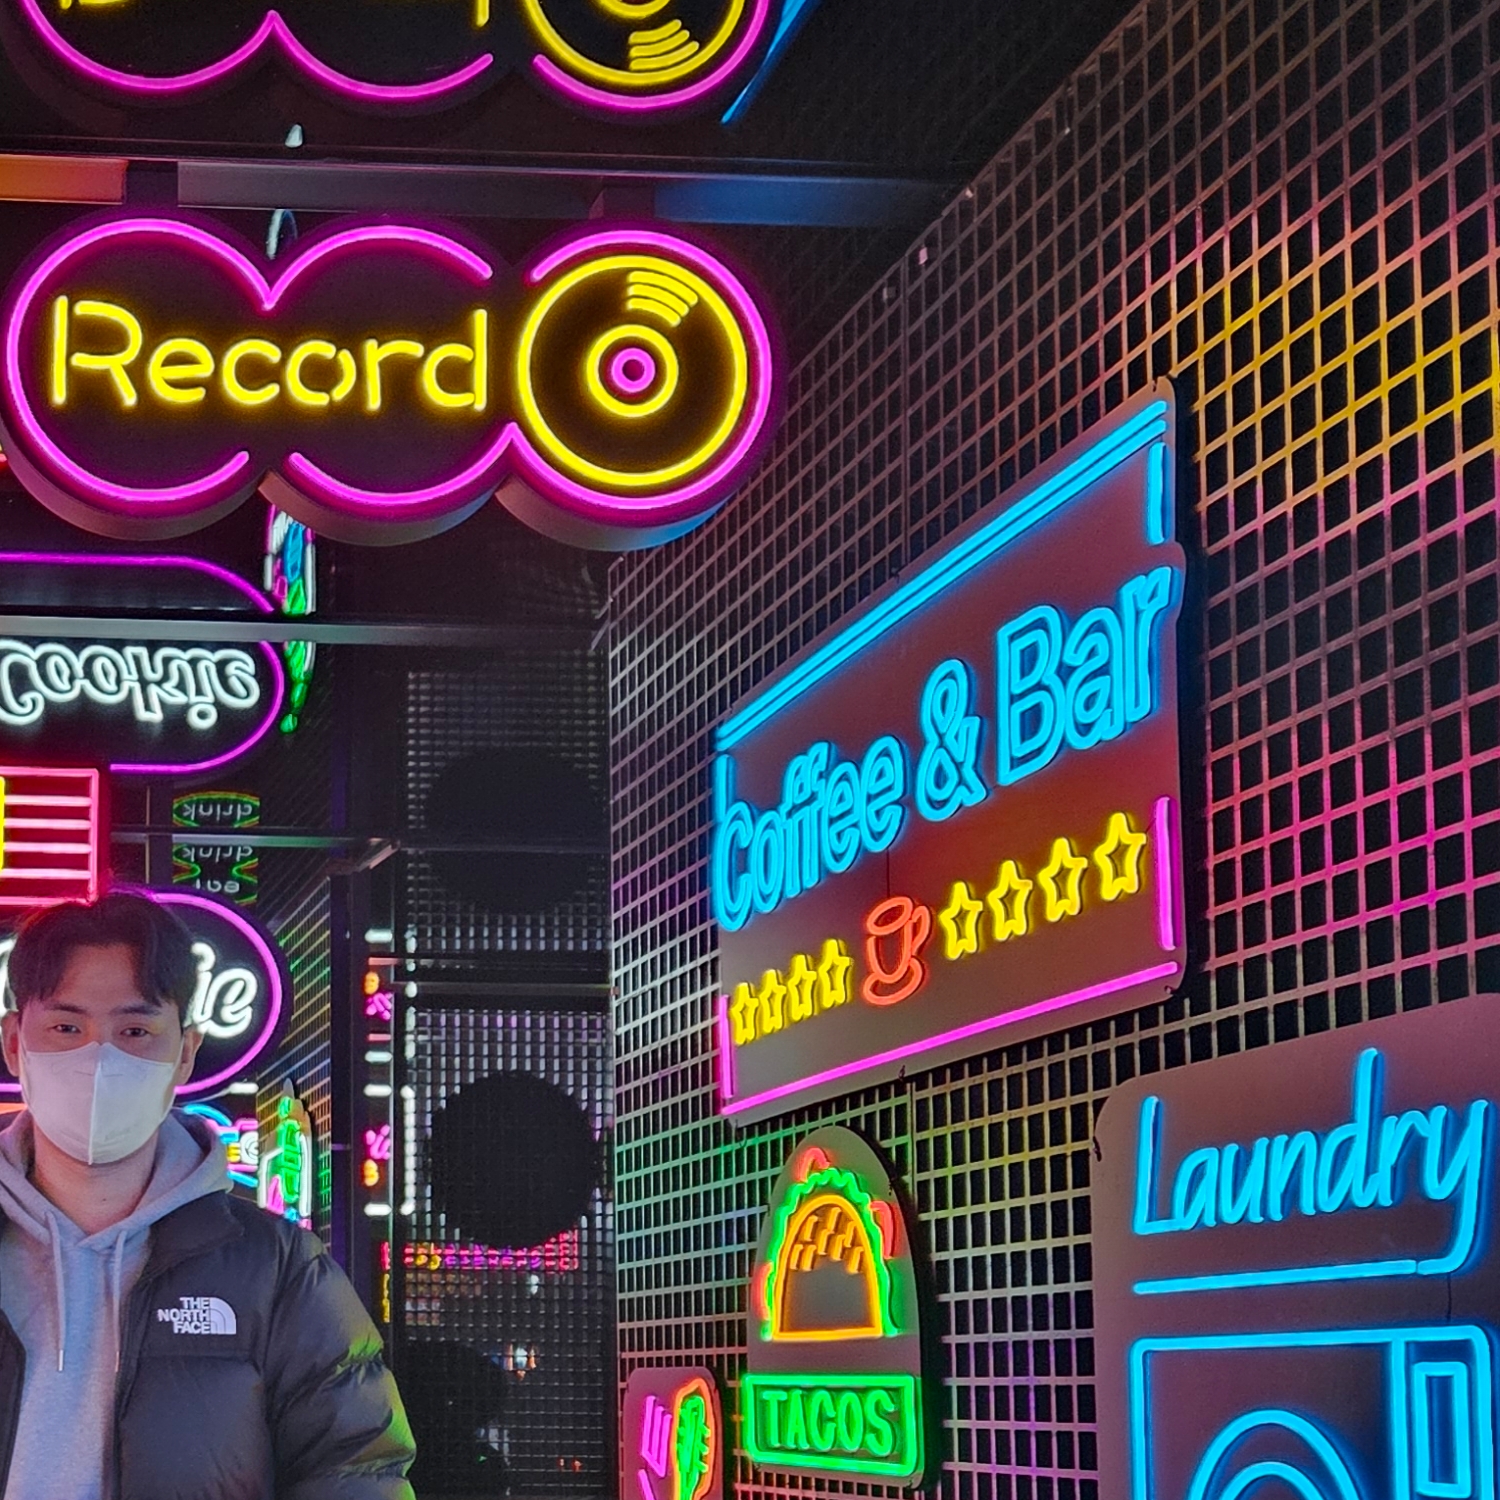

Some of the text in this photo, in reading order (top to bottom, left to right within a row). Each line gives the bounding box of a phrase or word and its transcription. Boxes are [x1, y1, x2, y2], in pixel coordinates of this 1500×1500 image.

[51, 294, 488, 410] Record
[712, 565, 1173, 931] Coffee & Bar
[1132, 1048, 1490, 1276] Laundry
[157, 1308, 210, 1322] NORTH
[173, 1321, 211, 1334] FACE
[179, 1296, 210, 1309] THE
[762, 1387, 897, 1458] TACOS
